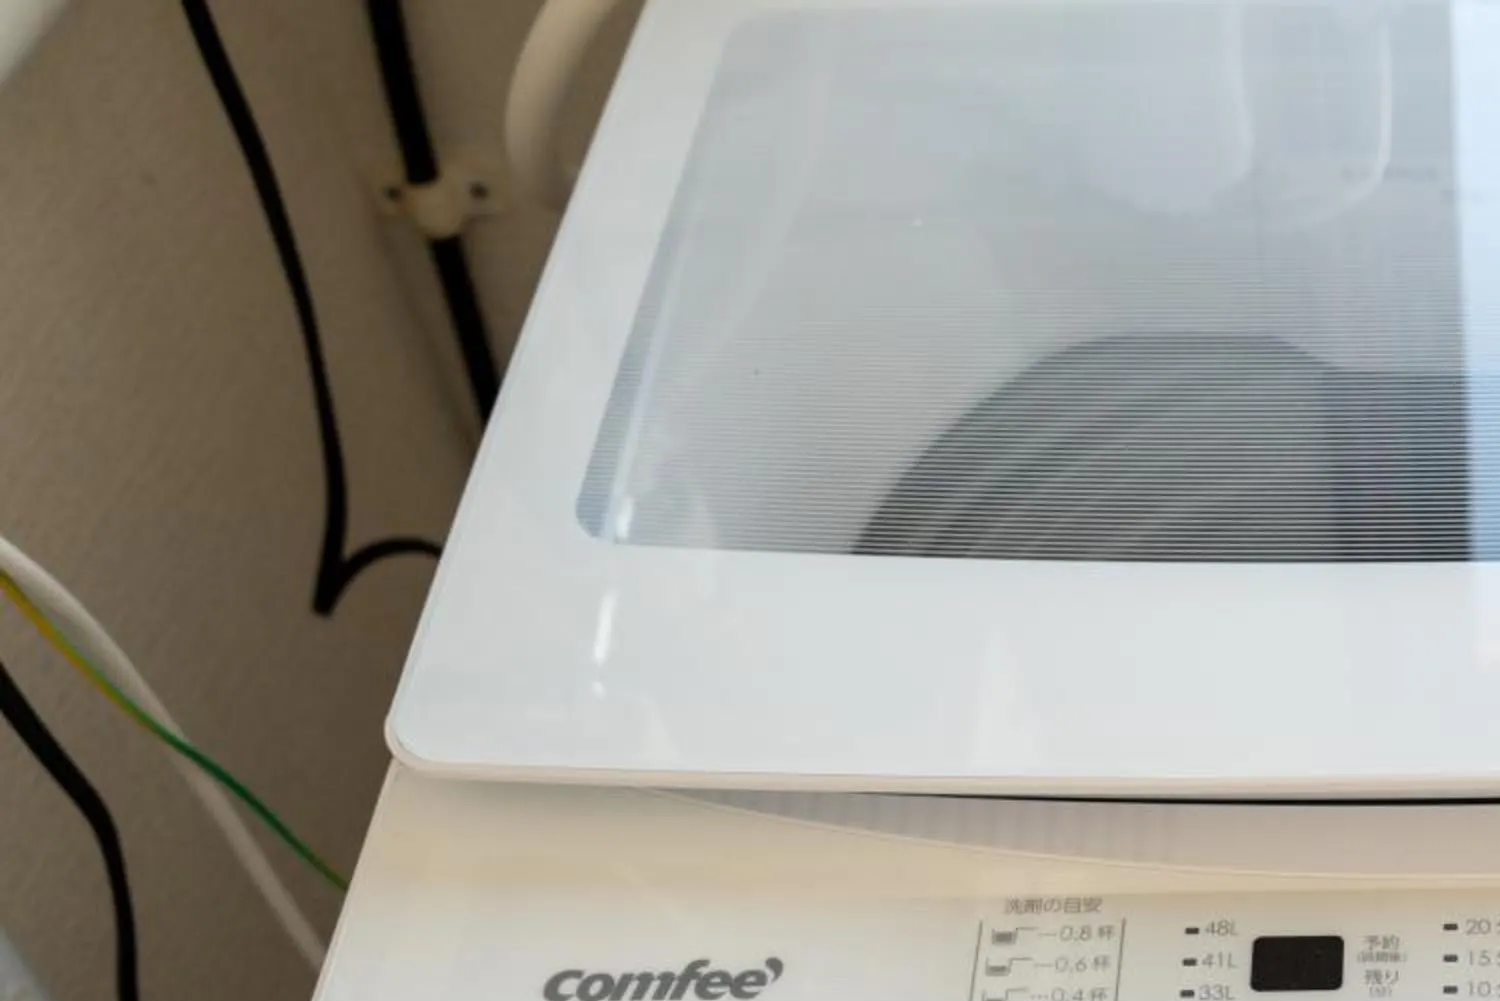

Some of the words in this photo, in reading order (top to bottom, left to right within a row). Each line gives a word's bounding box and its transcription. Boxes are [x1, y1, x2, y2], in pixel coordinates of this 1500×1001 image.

[1204, 920, 1238, 937] 48L
[1201, 952, 1237, 969] 41L
[1199, 985, 1235, 1001] 33L
